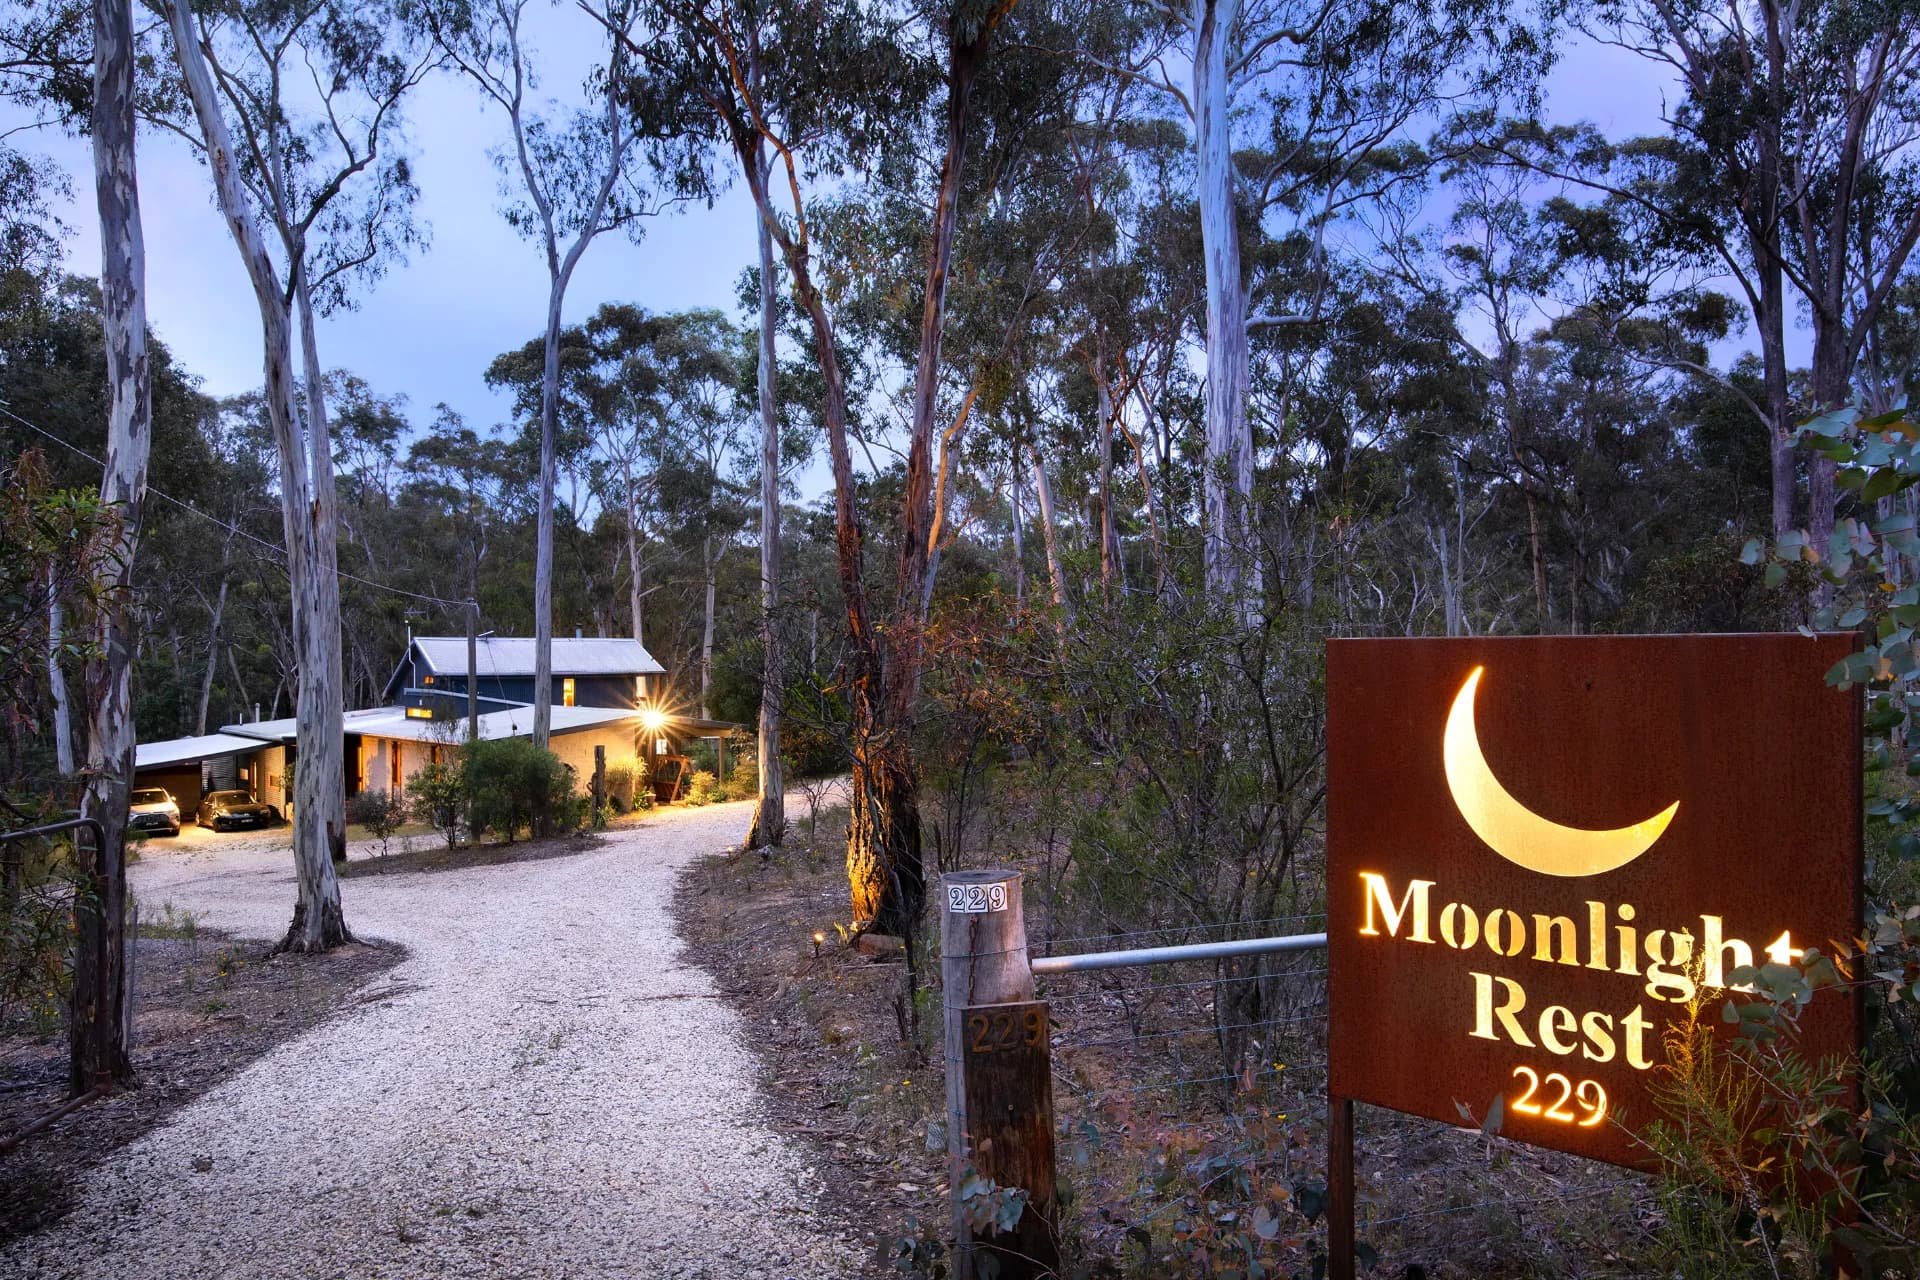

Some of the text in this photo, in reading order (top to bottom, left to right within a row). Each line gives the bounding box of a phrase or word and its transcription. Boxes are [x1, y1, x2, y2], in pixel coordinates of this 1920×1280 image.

[950, 885, 1006, 911] 229
[1359, 871, 1804, 1003] Moonlight
[968, 1008, 1043, 1053] 229
[1469, 972, 1654, 1070] Rest
[1511, 1065, 1609, 1127] 229
